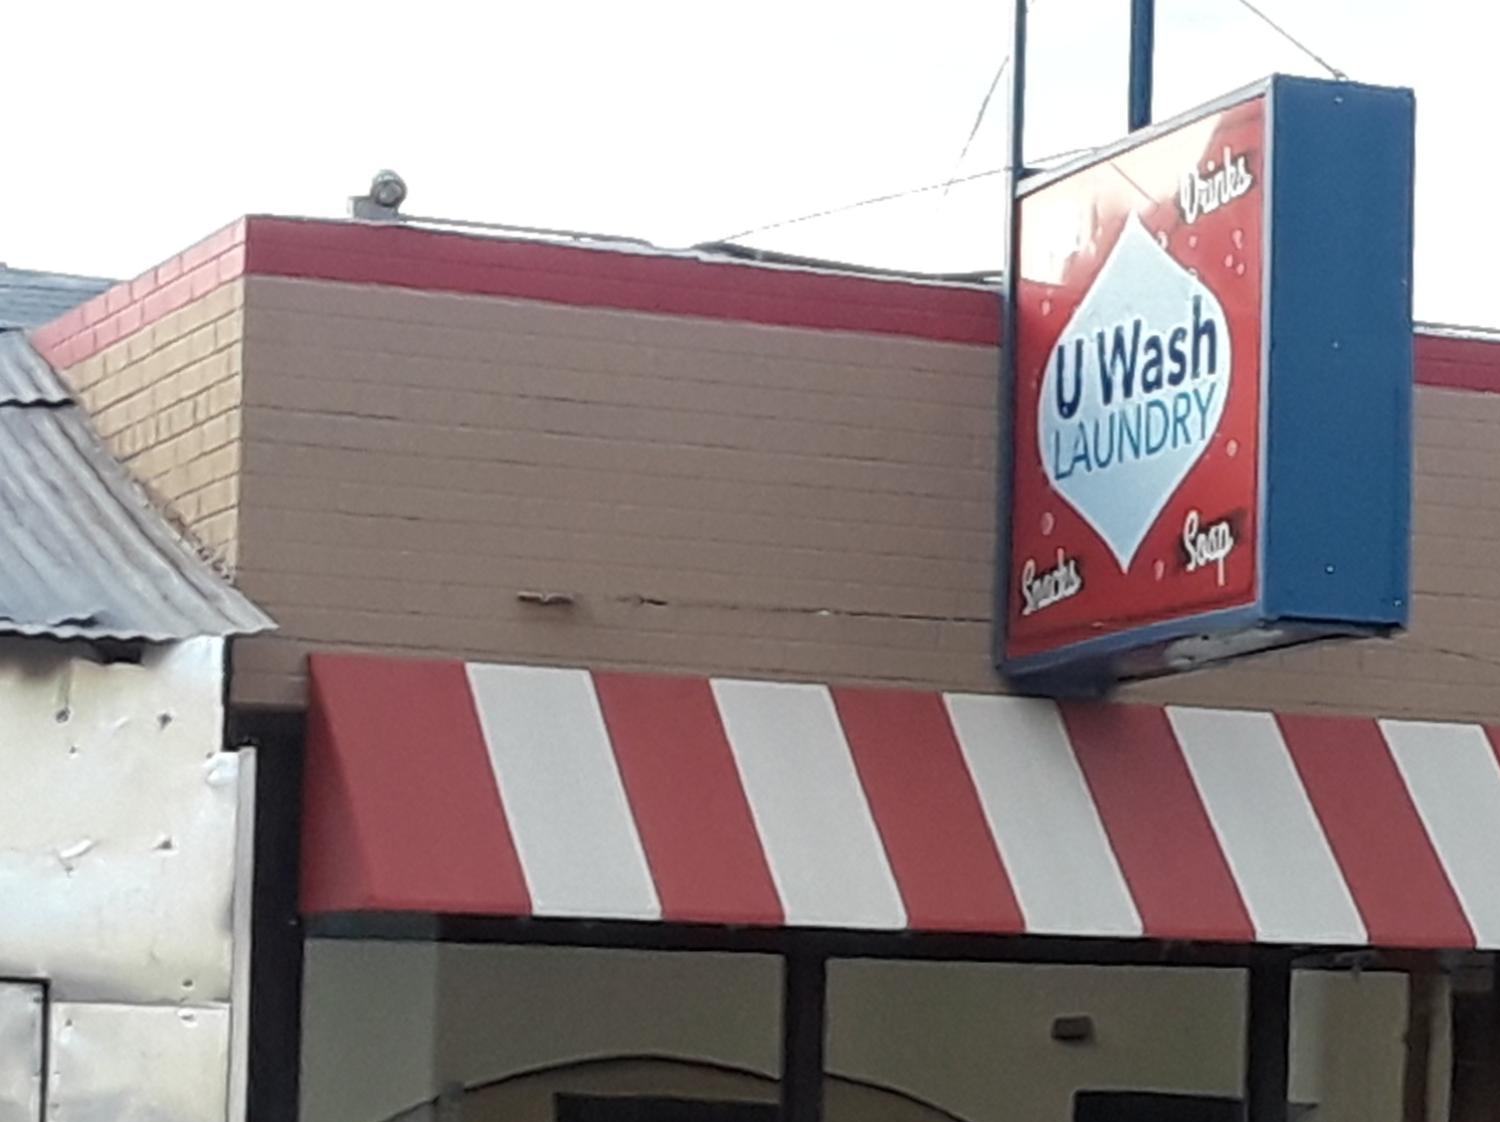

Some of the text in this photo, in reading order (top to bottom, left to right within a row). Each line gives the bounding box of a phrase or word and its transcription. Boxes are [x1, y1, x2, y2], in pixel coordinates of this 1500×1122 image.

[1179, 145, 1253, 224] Drinks
[1056, 294, 1217, 420] U Wash
[1054, 382, 1216, 481] LAUNDRY
[1183, 510, 1234, 586] Soap
